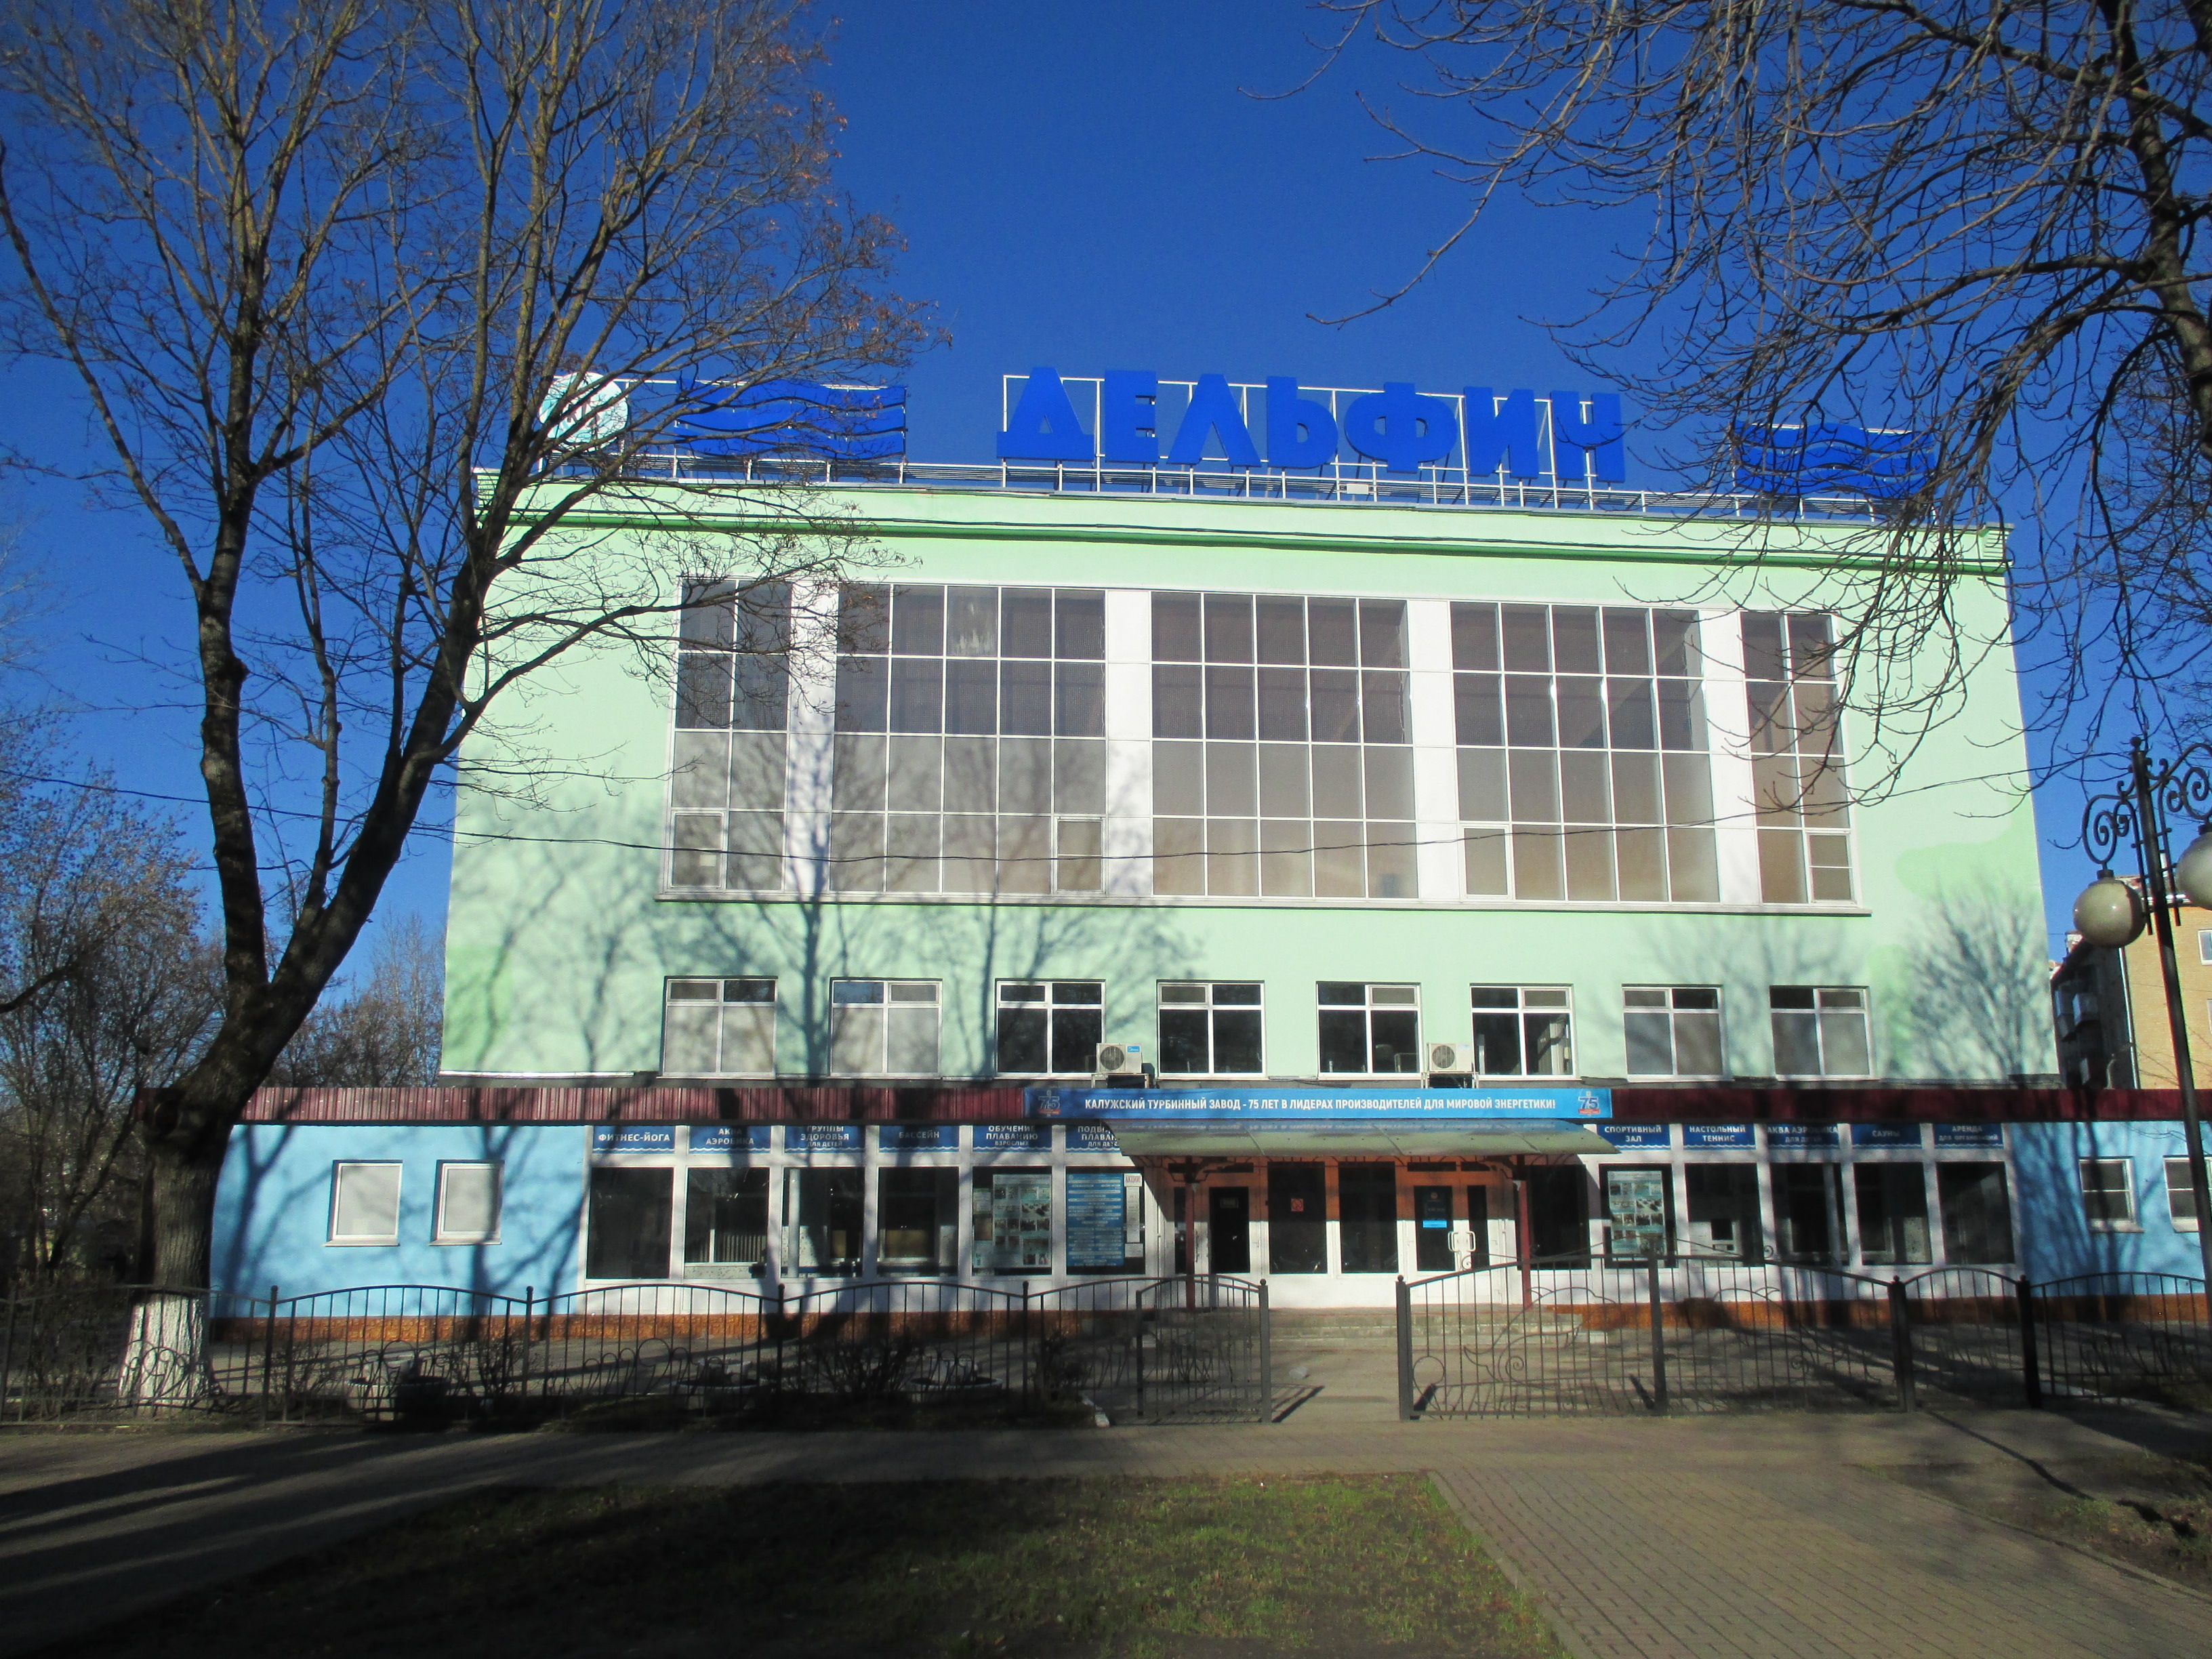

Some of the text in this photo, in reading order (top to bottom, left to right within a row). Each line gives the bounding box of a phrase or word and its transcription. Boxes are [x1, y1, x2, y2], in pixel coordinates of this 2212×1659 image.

[996, 367, 1625, 483] ДЕЛЬФИН
[1085, 1097, 1145, 1109] КАЛУЖСКИЙ
[1147, 1097, 1207, 1109] ТУРБИННЫЙ
[1209, 1099, 1241, 1111] ЗАВОД
[1248, 1099, 1259, 1109] 75
[1261, 1099, 1279, 1109] ЛЕТ
[1282, 1099, 1288, 1109] В
[1289, 1099, 1334, 1110] ЛИДЕРАХ
[1335, 1097, 1422, 1110] ПРОИЗВОДИТЕЛЕЙ
[1424, 1099, 1444, 1110] ДЛЯ
[1446, 1097, 1492, 1109] МИРОВОЙ
[1494, 1099, 1556, 1109] ЭНЕРГЕТИКИ!
[1578, 1097, 1599, 1109] 75
[718, 1128, 743, 1136] АКВА
[1604, 1124, 1662, 1134] СПОРТИВНЫЙ
[1689, 1125, 1746, 1134] НАСТОЛЬНЫЙ
[598, 1131, 671, 1143] ФИТНЕС-ЙОГА
[800, 1133, 850, 1141] ЗДОРОВЬЯ
[899, 1130, 940, 1139] БАССЕЙН
[1702, 1134, 1735, 1143] ТЕННИС
[705, 1137, 755, 1145] АЭРОБИКА
